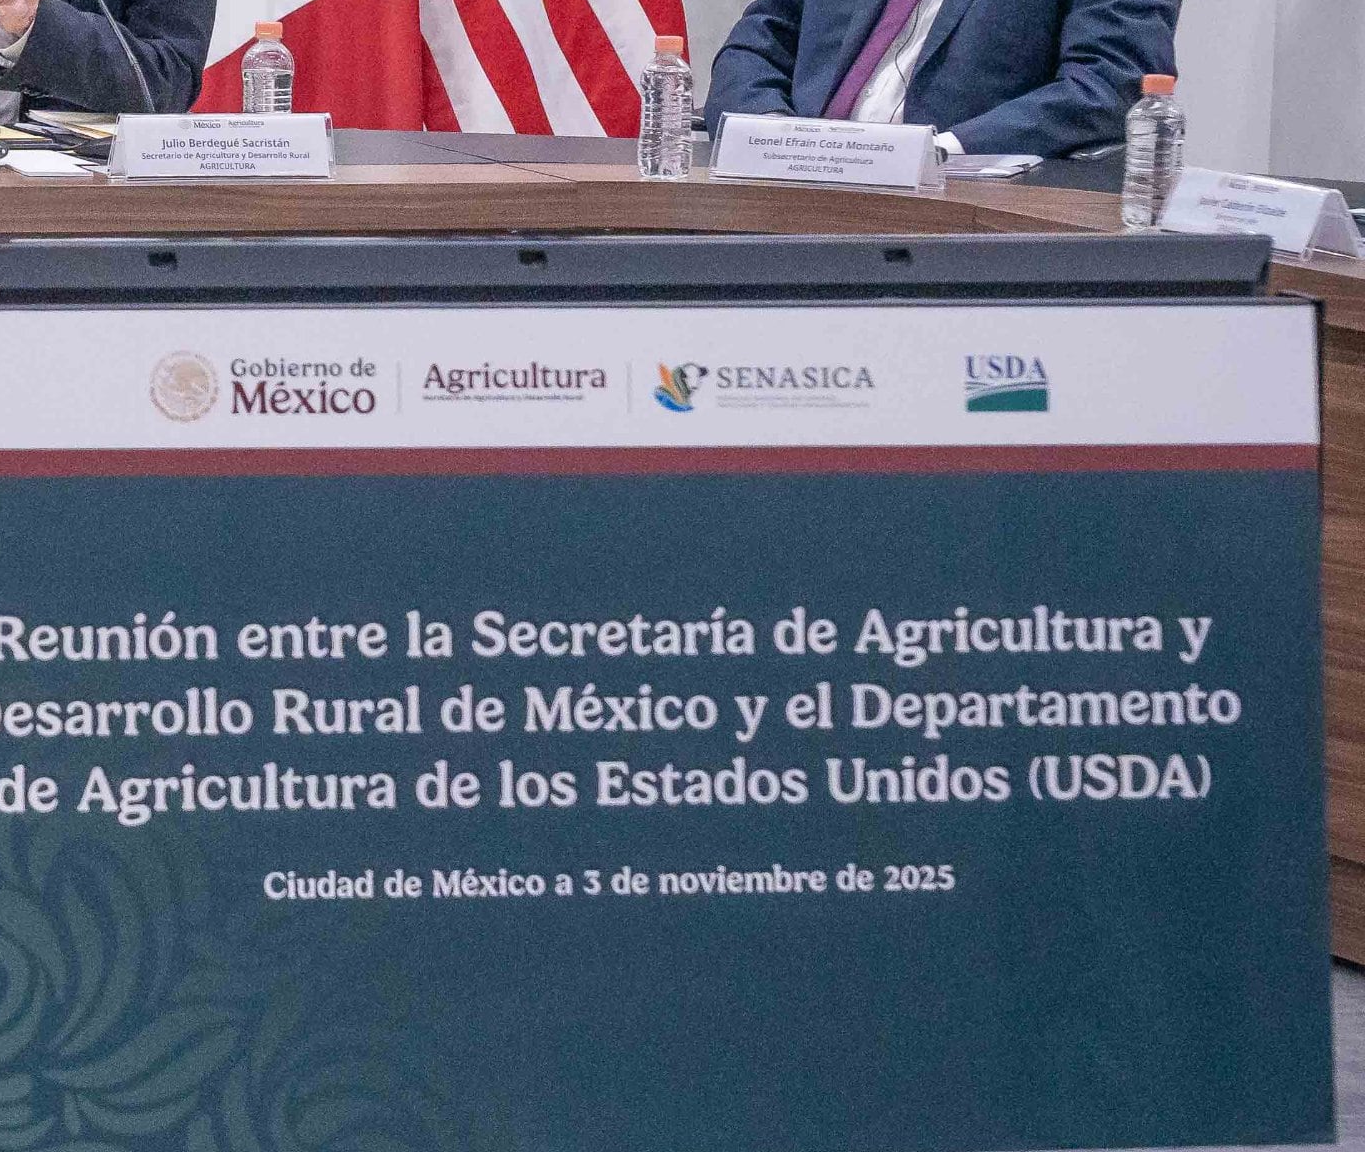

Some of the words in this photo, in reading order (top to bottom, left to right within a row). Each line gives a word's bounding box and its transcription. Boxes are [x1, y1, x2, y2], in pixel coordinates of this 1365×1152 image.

[162, 139, 185, 150] Julio
[189, 138, 239, 150] Berdegué
[242, 138, 289, 147] Sacristán
[749, 136, 783, 146] Leonel
[819, 140, 842, 149] Cota
[846, 141, 894, 152] Montaño
[196, 152, 239, 160] Agricultura
[763, 152, 815, 161] Subsecretario
[788, 165, 843, 174] AGRICULTURA
[231, 358, 342, 377] Gobierno
[350, 357, 376, 377] de
[424, 362, 606, 393] Agricultura
[716, 366, 875, 389] SENASICA
[966, 355, 1047, 379] USDA
[231, 380, 376, 414] México
[237, 616, 388, 659] entre
[406, 610, 453, 658] la
[471, 606, 755, 658] Secretaría
[773, 606, 838, 655] de
[853, 604, 1163, 668] Agricultura
[1177, 616, 1213, 664] y
[272, 685, 422, 735] Rural
[440, 684, 506, 733] de
[523, 682, 718, 733] México
[734, 695, 769, 743] y
[785, 681, 834, 729] el
[850, 683, 1241, 740] Departamento
[76, 761, 396, 827] Agricultura
[415, 759, 481, 808] de
[498, 759, 578, 808] los
[595, 756, 809, 807] Estados
[825, 753, 1011, 804] Unidos
[1028, 753, 1212, 801] (USDA)
[263, 869, 374, 901] Ciudad
[383, 868, 423, 899] de
[431, 867, 546, 898] México
[554, 873, 574, 896] a
[582, 869, 602, 896] 3
[610, 865, 650, 896] de
[658, 863, 827, 895] noviembre
[835, 862, 875, 892] de
[883, 864, 956, 892] 2025
